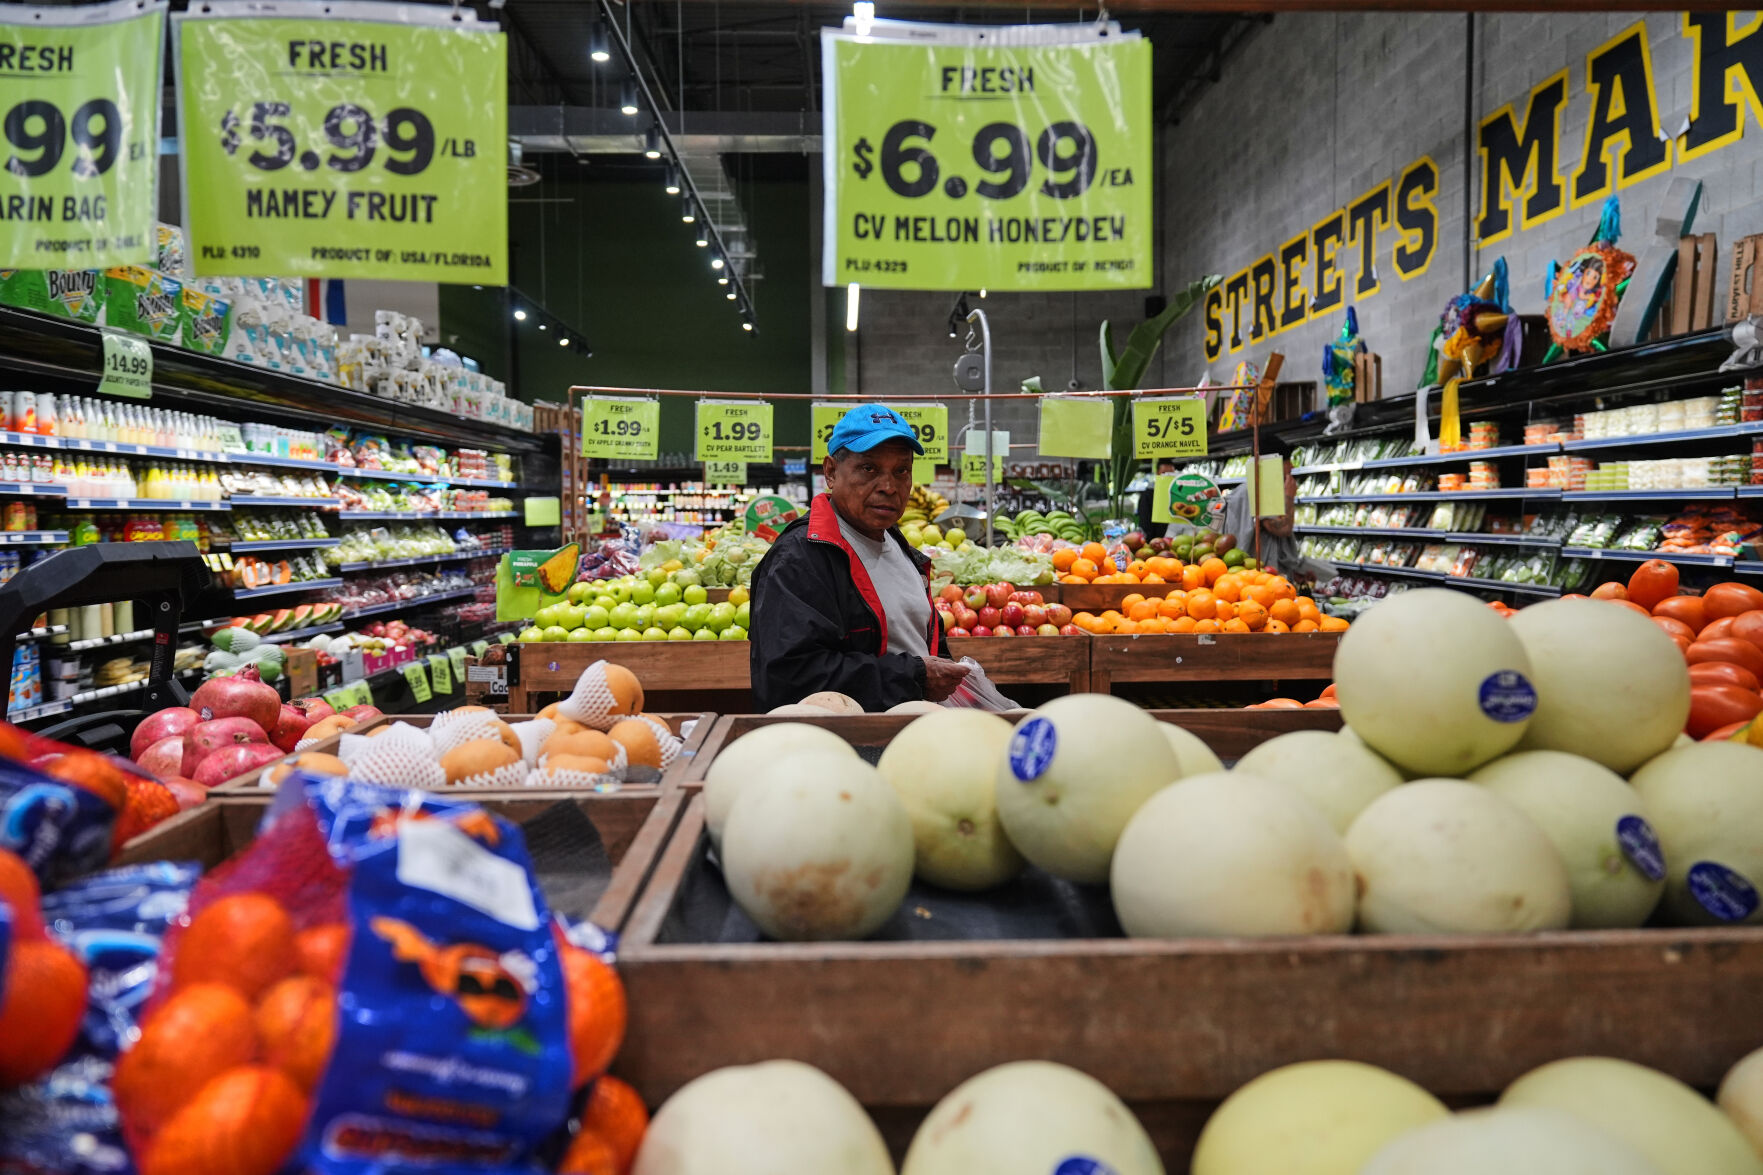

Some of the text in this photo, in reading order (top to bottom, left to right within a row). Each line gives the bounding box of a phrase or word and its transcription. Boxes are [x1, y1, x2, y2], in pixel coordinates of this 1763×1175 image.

[289, 40, 388, 71] FRESH
[941, 67, 1034, 92] FRESH
[220, 101, 477, 175] $5.99 /LB
[853, 119, 1134, 200] $6.99 /EA
[63, 195, 108, 221] BAG
[246, 188, 438, 224] MAMEY FRUIT
[854, 212, 1126, 243] CV MELON HONEYDEW
[36, 240, 92, 252] PRODUCT
[311, 246, 371, 261] PRODUCT
[401, 250, 492, 268] USA/FLORIDA
[1017, 261, 1068, 273] PRODUCT
[1203, 154, 1440, 364] STREETS
[48, 270, 96, 299] Bounty
[1731, 242, 1744, 318] HARVEST HILLS
[610, 404, 633, 413] FRESH
[725, 408, 748, 416] FRESH
[1159, 404, 1181, 412] FRESH
[594, 419, 642, 437] $1.99
[704, 421, 761, 441] $1.99
[1147, 417, 1194, 438] 5/$5
[706, 444, 715, 452] CV
[734, 445, 766, 453] BARTLETT
[1152, 440, 1177, 449] ORANGE
